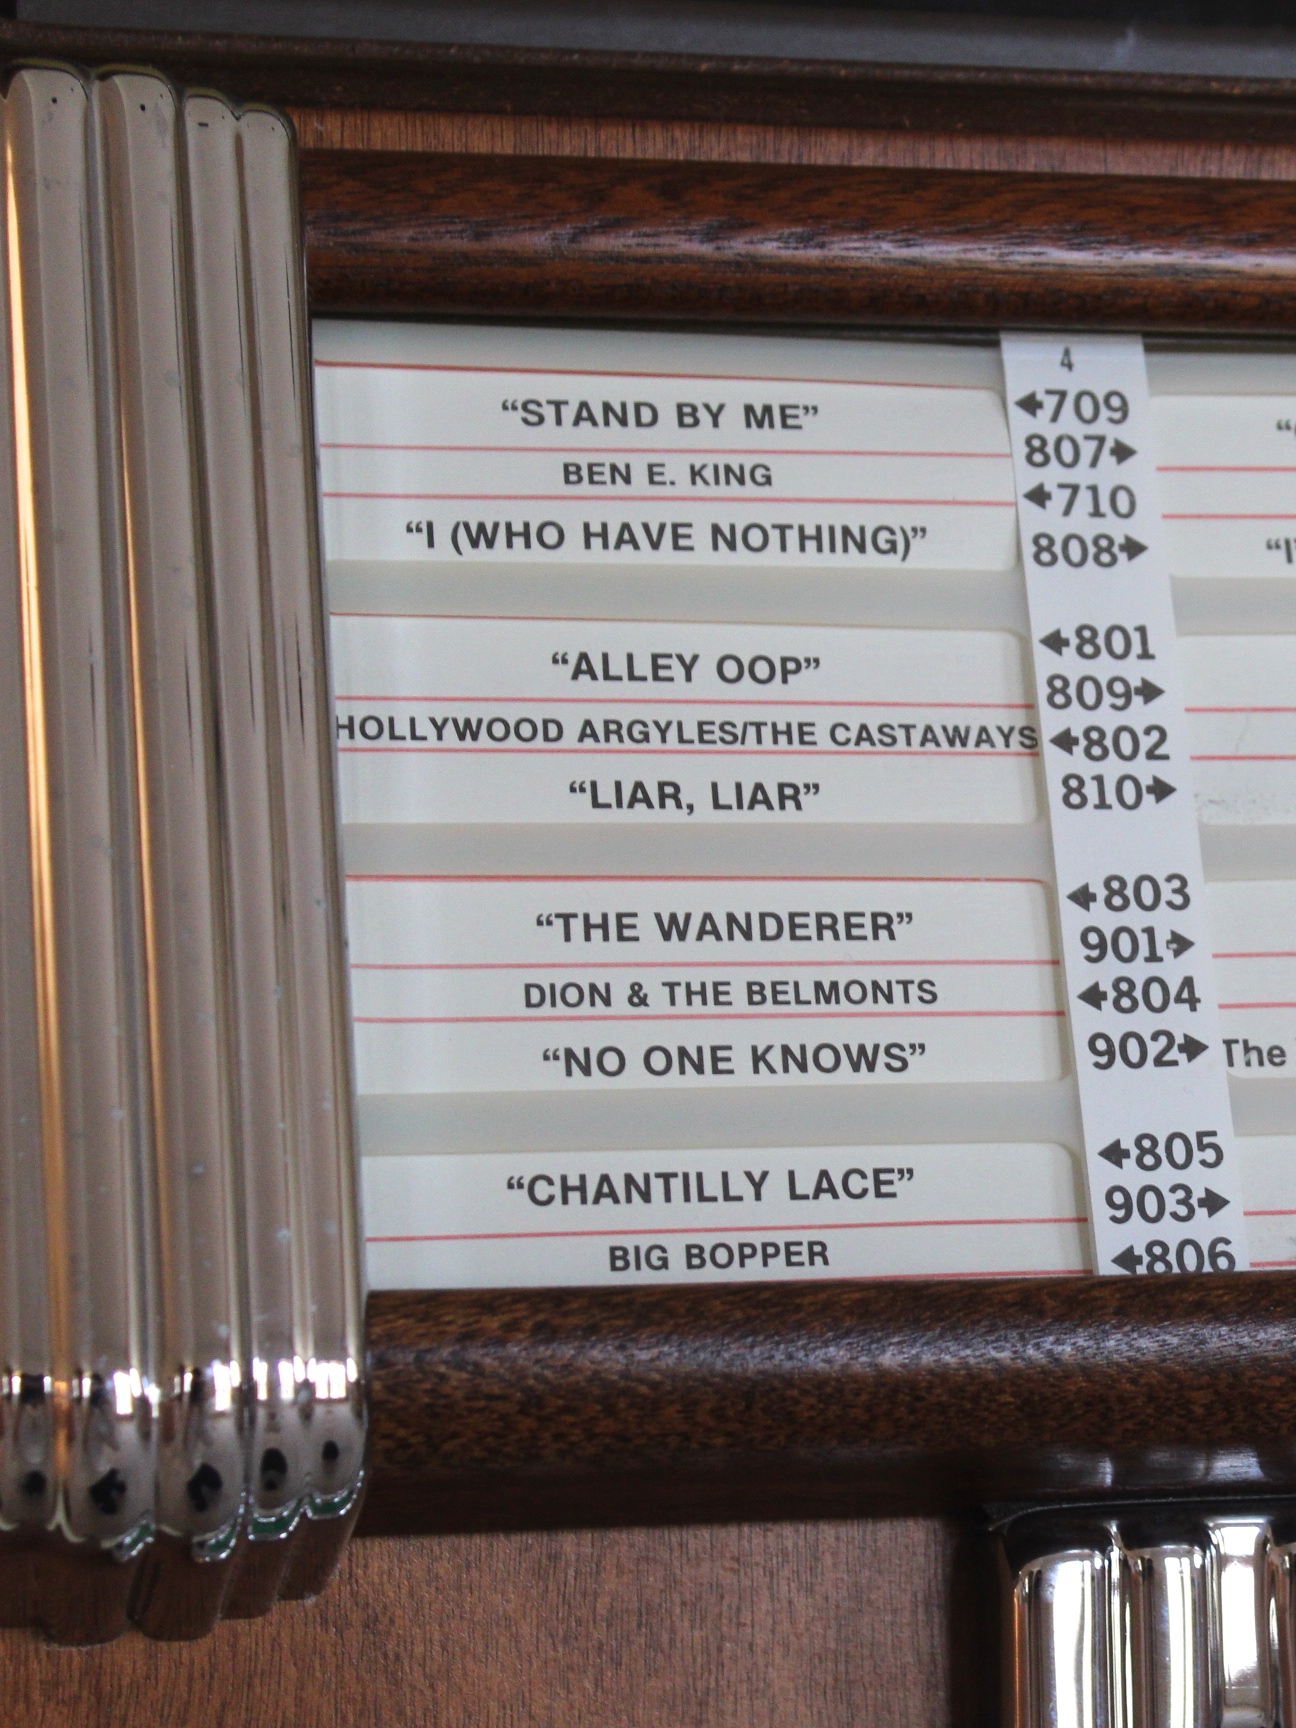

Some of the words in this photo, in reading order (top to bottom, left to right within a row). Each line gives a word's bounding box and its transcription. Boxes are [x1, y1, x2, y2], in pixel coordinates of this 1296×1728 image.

[1060, 345, 1075, 373] 4
[501, 398, 659, 428] “STAND
[676, 402, 726, 429] BY
[743, 403, 820, 431] ME”
[1044, 388, 1130, 425] 709
[1024, 433, 1107, 469] 807
[562, 462, 632, 486] BEN
[646, 462, 676, 486] E.
[689, 463, 773, 487] KING
[1056, 482, 1137, 519] 710
[405, 520, 435, 549] “I
[450, 520, 565, 556] (WHO
[582, 521, 695, 552] HAVE
[710, 522, 928, 562] NOTHING)”
[1031, 532, 1119, 569] 808
[1074, 623, 1156, 661] 801
[551, 651, 700, 683] “ALLEY
[716, 654, 821, 685] OOP”
[1046, 673, 1133, 712] 809
[335, 714, 564, 743] HOLLYWOOD
[577, 718, 818, 746] ARGYLES/THE
[829, 722, 1039, 751] CASTAWAYS
[1082, 724, 1171, 763] 802
[569, 779, 694, 816] “LIAR,
[710, 781, 820, 811] LIAR”
[1061, 772, 1144, 811] 810
[1102, 872, 1191, 913] 803
[536, 911, 640, 943] “THE
[653, 911, 913, 942] WANDERER”
[1079, 925, 1164, 964] 901
[524, 981, 612, 1009] DION
[627, 981, 650, 1008] &
[661, 980, 733, 1007] THE
[746, 979, 938, 1006] BELMONTS
[1111, 975, 1202, 1015] 804
[542, 1045, 626, 1078] “NO
[643, 1044, 735, 1077] ONE
[750, 1042, 926, 1075] KNOWS”
[1087, 1029, 1179, 1071] 902
[1222, 1038, 1287, 1068] The
[1133, 1130, 1224, 1172] 805
[506, 1170, 770, 1207] “CHANTILLY
[787, 1167, 914, 1201] LACE”
[1104, 1182, 1196, 1225] 903
[608, 1244, 669, 1272] BIG
[685, 1240, 830, 1270] BOPPER
[1144, 1236, 1237, 1275] 806
